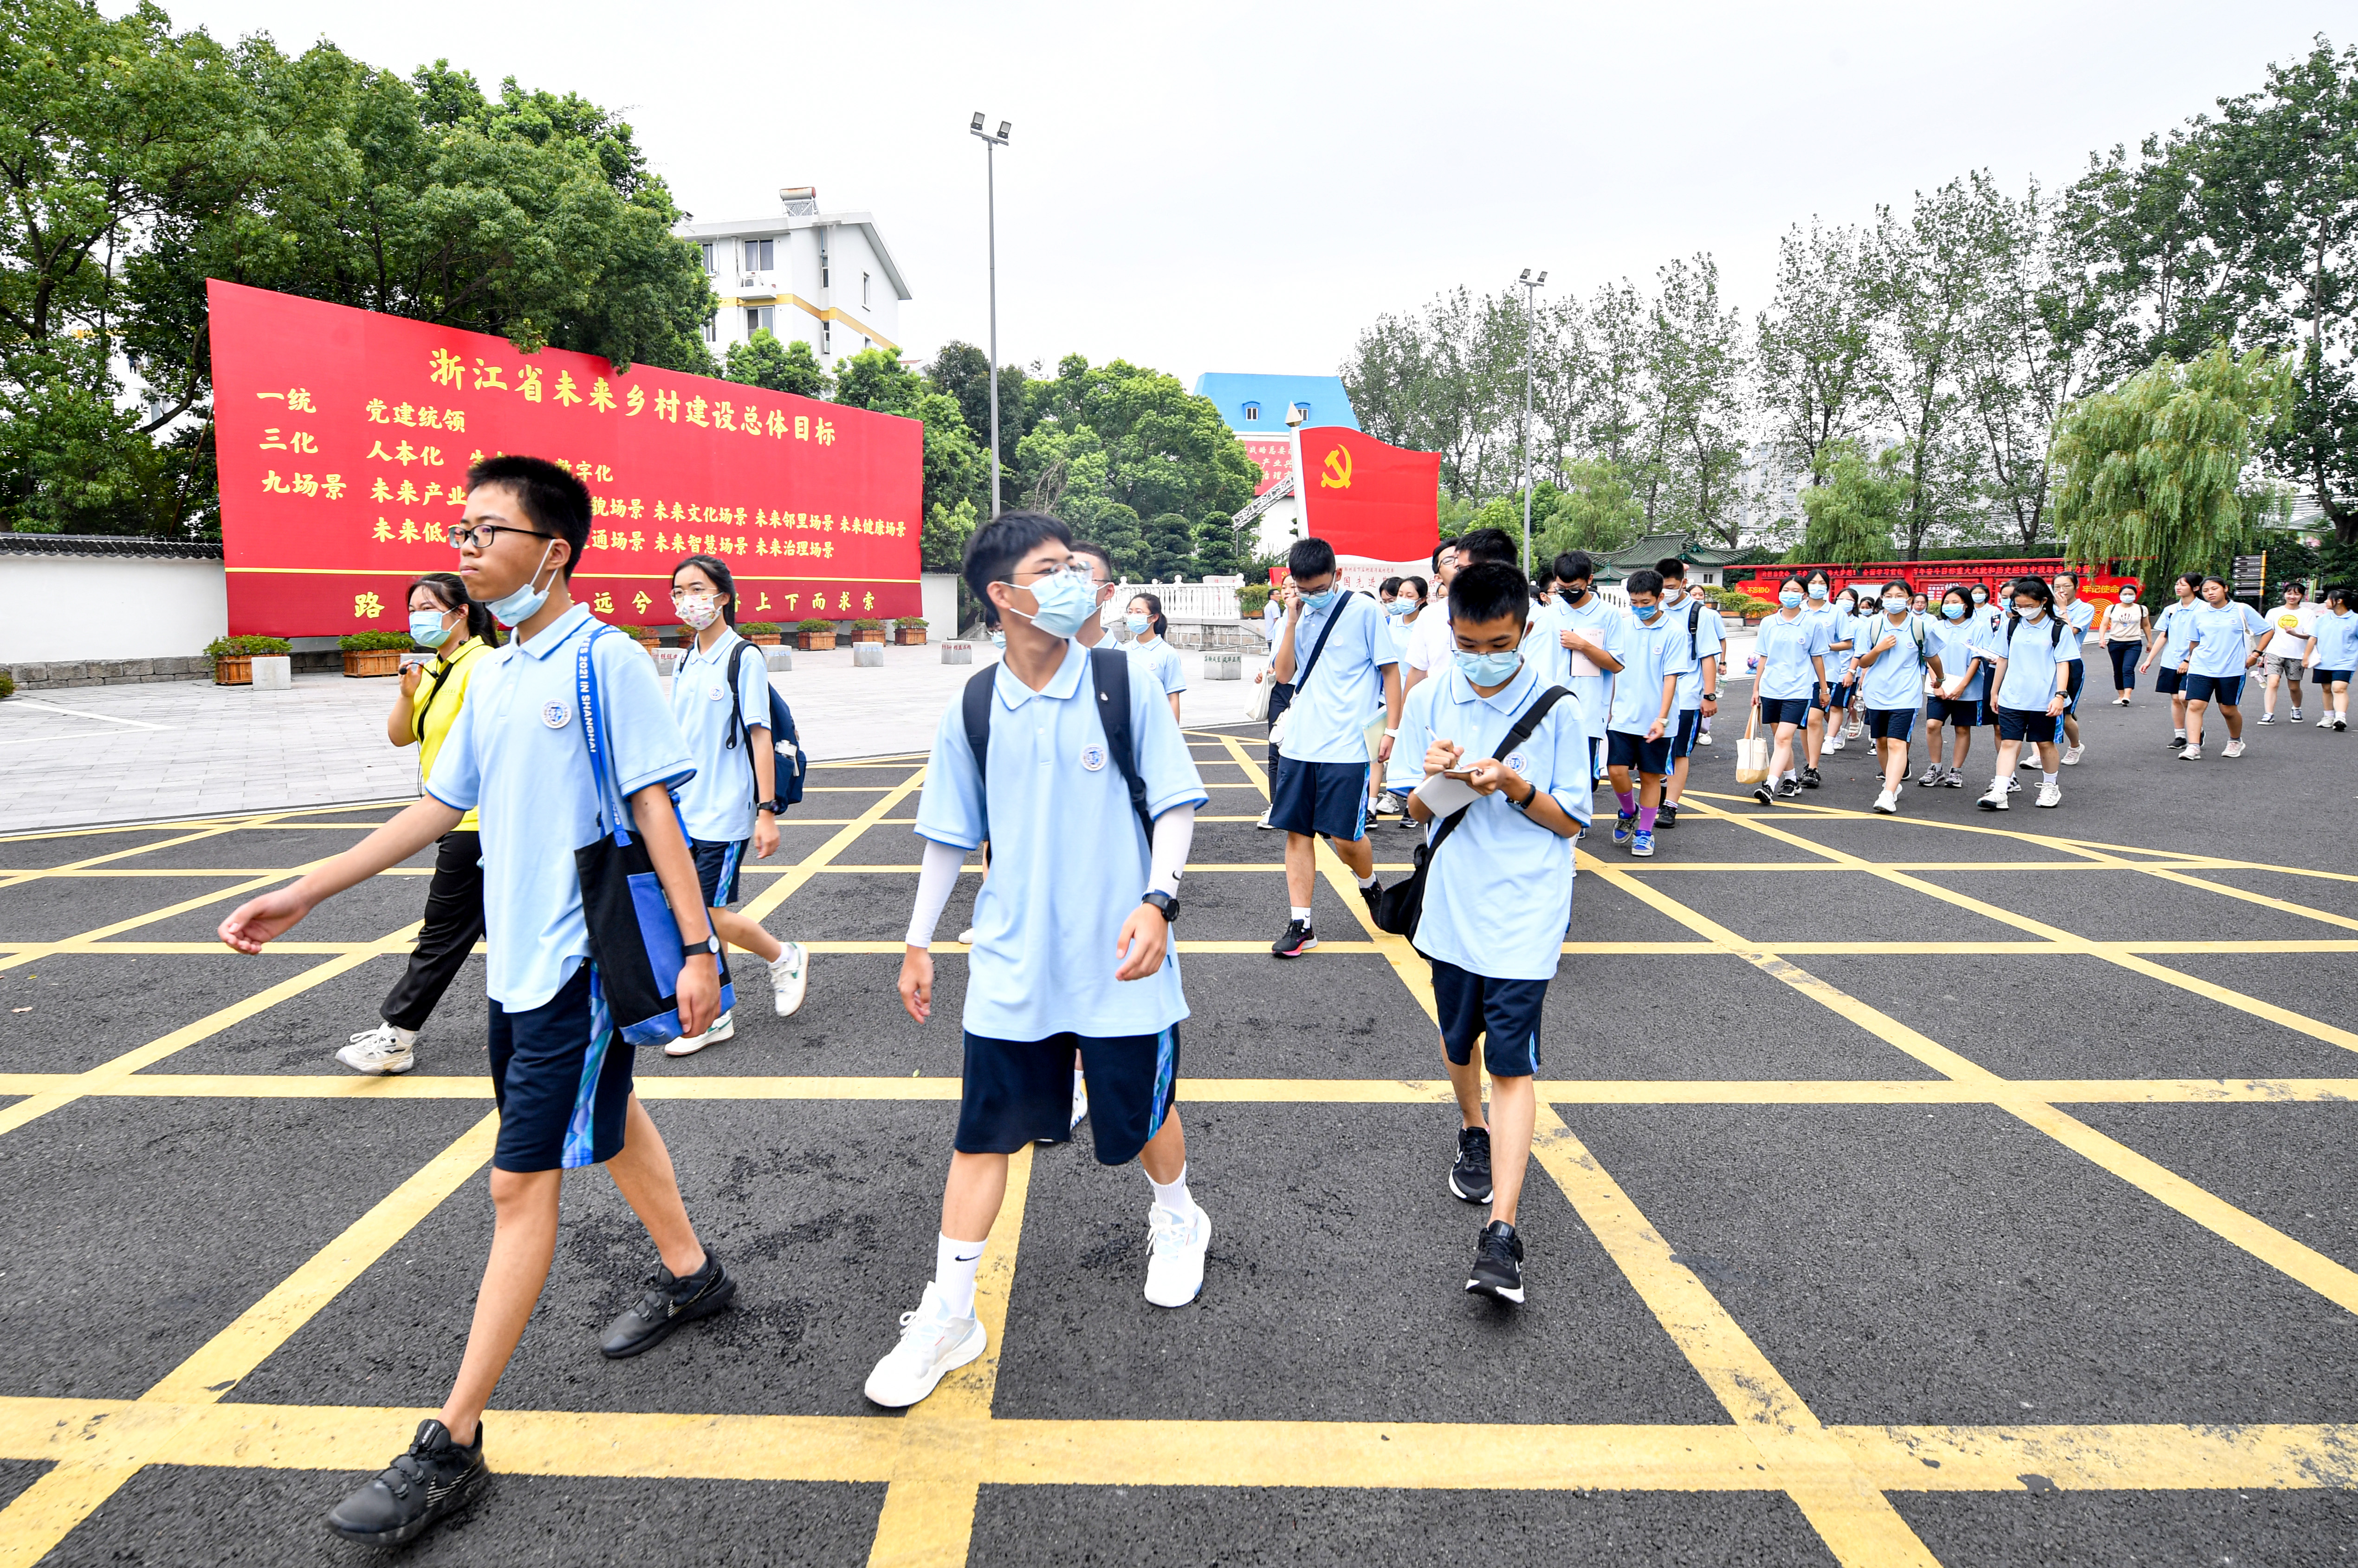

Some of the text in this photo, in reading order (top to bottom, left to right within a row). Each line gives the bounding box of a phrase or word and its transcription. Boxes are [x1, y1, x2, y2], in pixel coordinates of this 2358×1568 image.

[257, 387, 317, 413] 一统
[429, 348, 836, 446] 浙江省未来乡村建设总体目标
[366, 398, 465, 433] 党建统领
[259, 428, 318, 454] 三化
[366, 439, 444, 466] 人本化
[1244, 445, 1292, 455] 战略总要
[261, 470, 347, 500] 九场景
[654, 500, 748, 526] 未来文化场景
[755, 508, 834, 533] 未来邻里场景
[840, 516, 906, 538] 未来健康场景
[371, 516, 834, 559] 未来低 通场景 未来智慧场景 未来治理场景
[735, 591, 875, 613] 上下而求索
[2082, 585, 2119, 594] 牢记使命
[579, 656, 589, 679] 2021
[579, 681, 590, 693] IN
[581, 695, 597, 753] SHANGHAI
